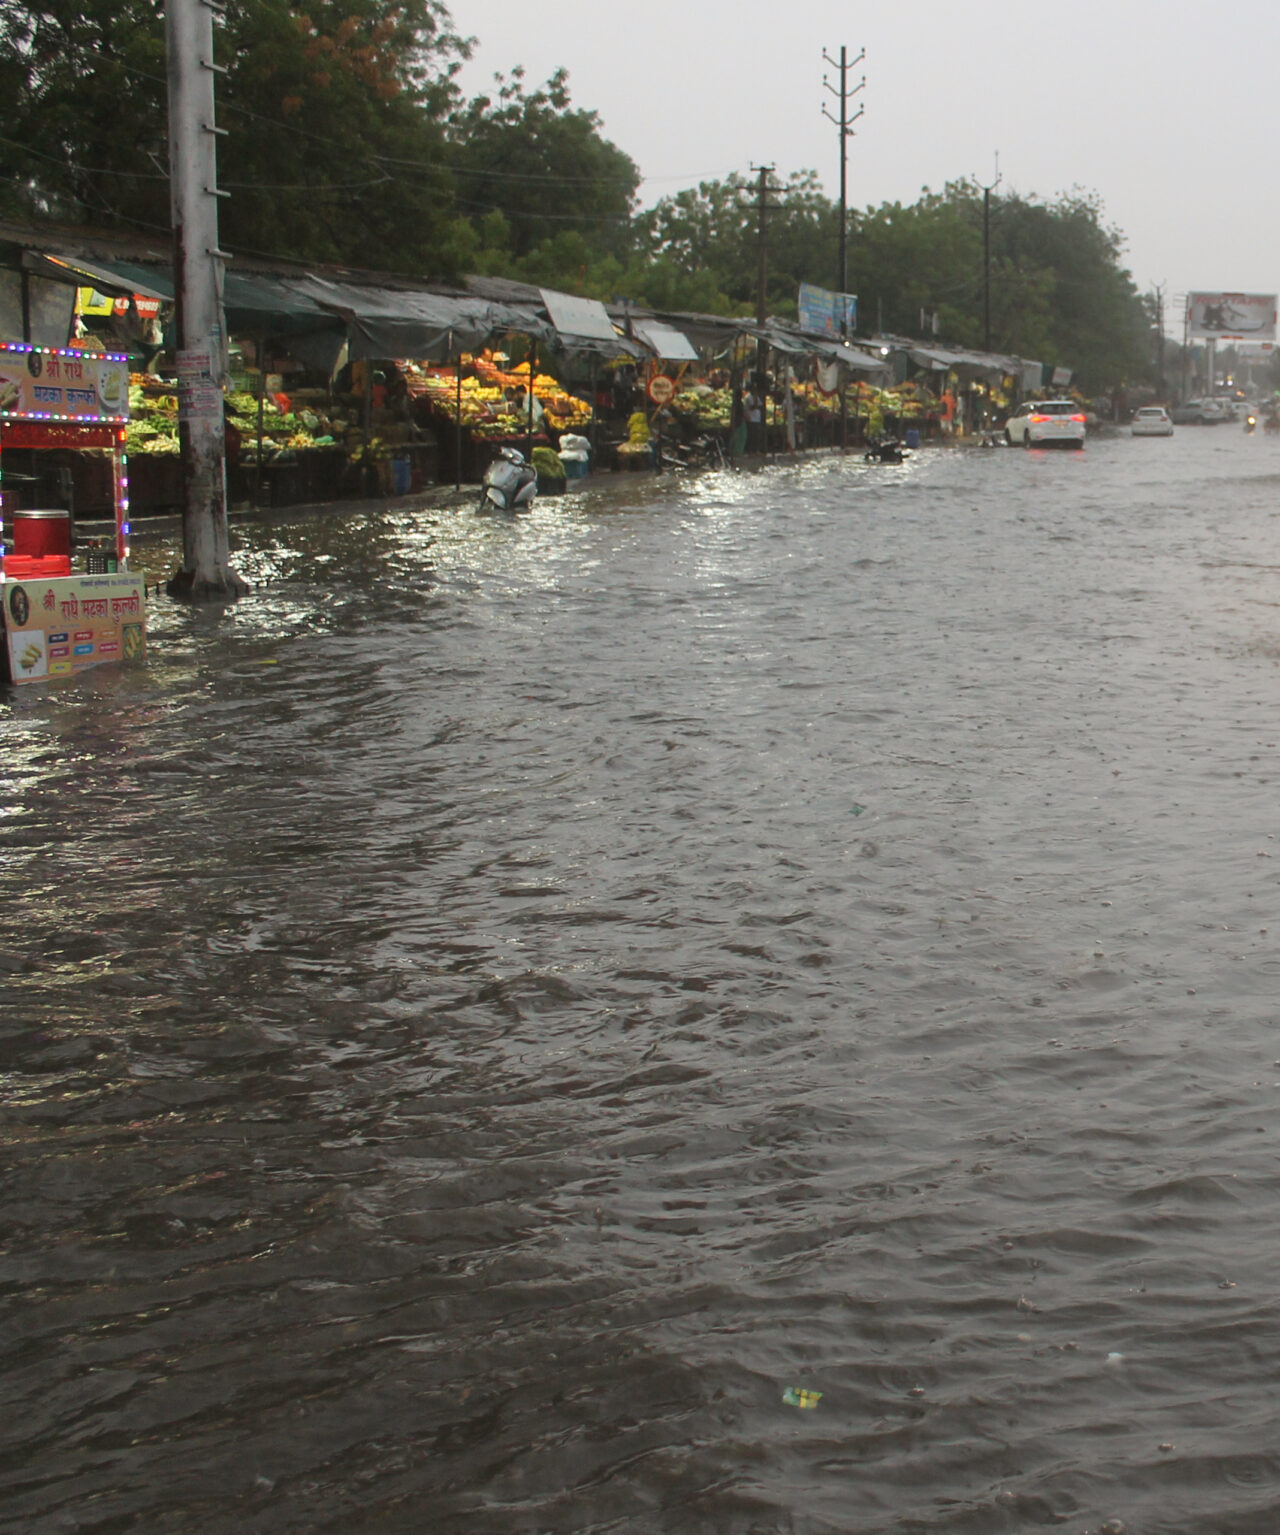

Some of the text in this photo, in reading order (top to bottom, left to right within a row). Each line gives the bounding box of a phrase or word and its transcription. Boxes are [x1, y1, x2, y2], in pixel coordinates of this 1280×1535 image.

[46, 354, 60, 378] श्री
[63, 358, 83, 380] राधे
[33, 383, 96, 413] मटका कुल्फी
[44, 588, 139, 625] श्री राधे मटका कुल्फी
